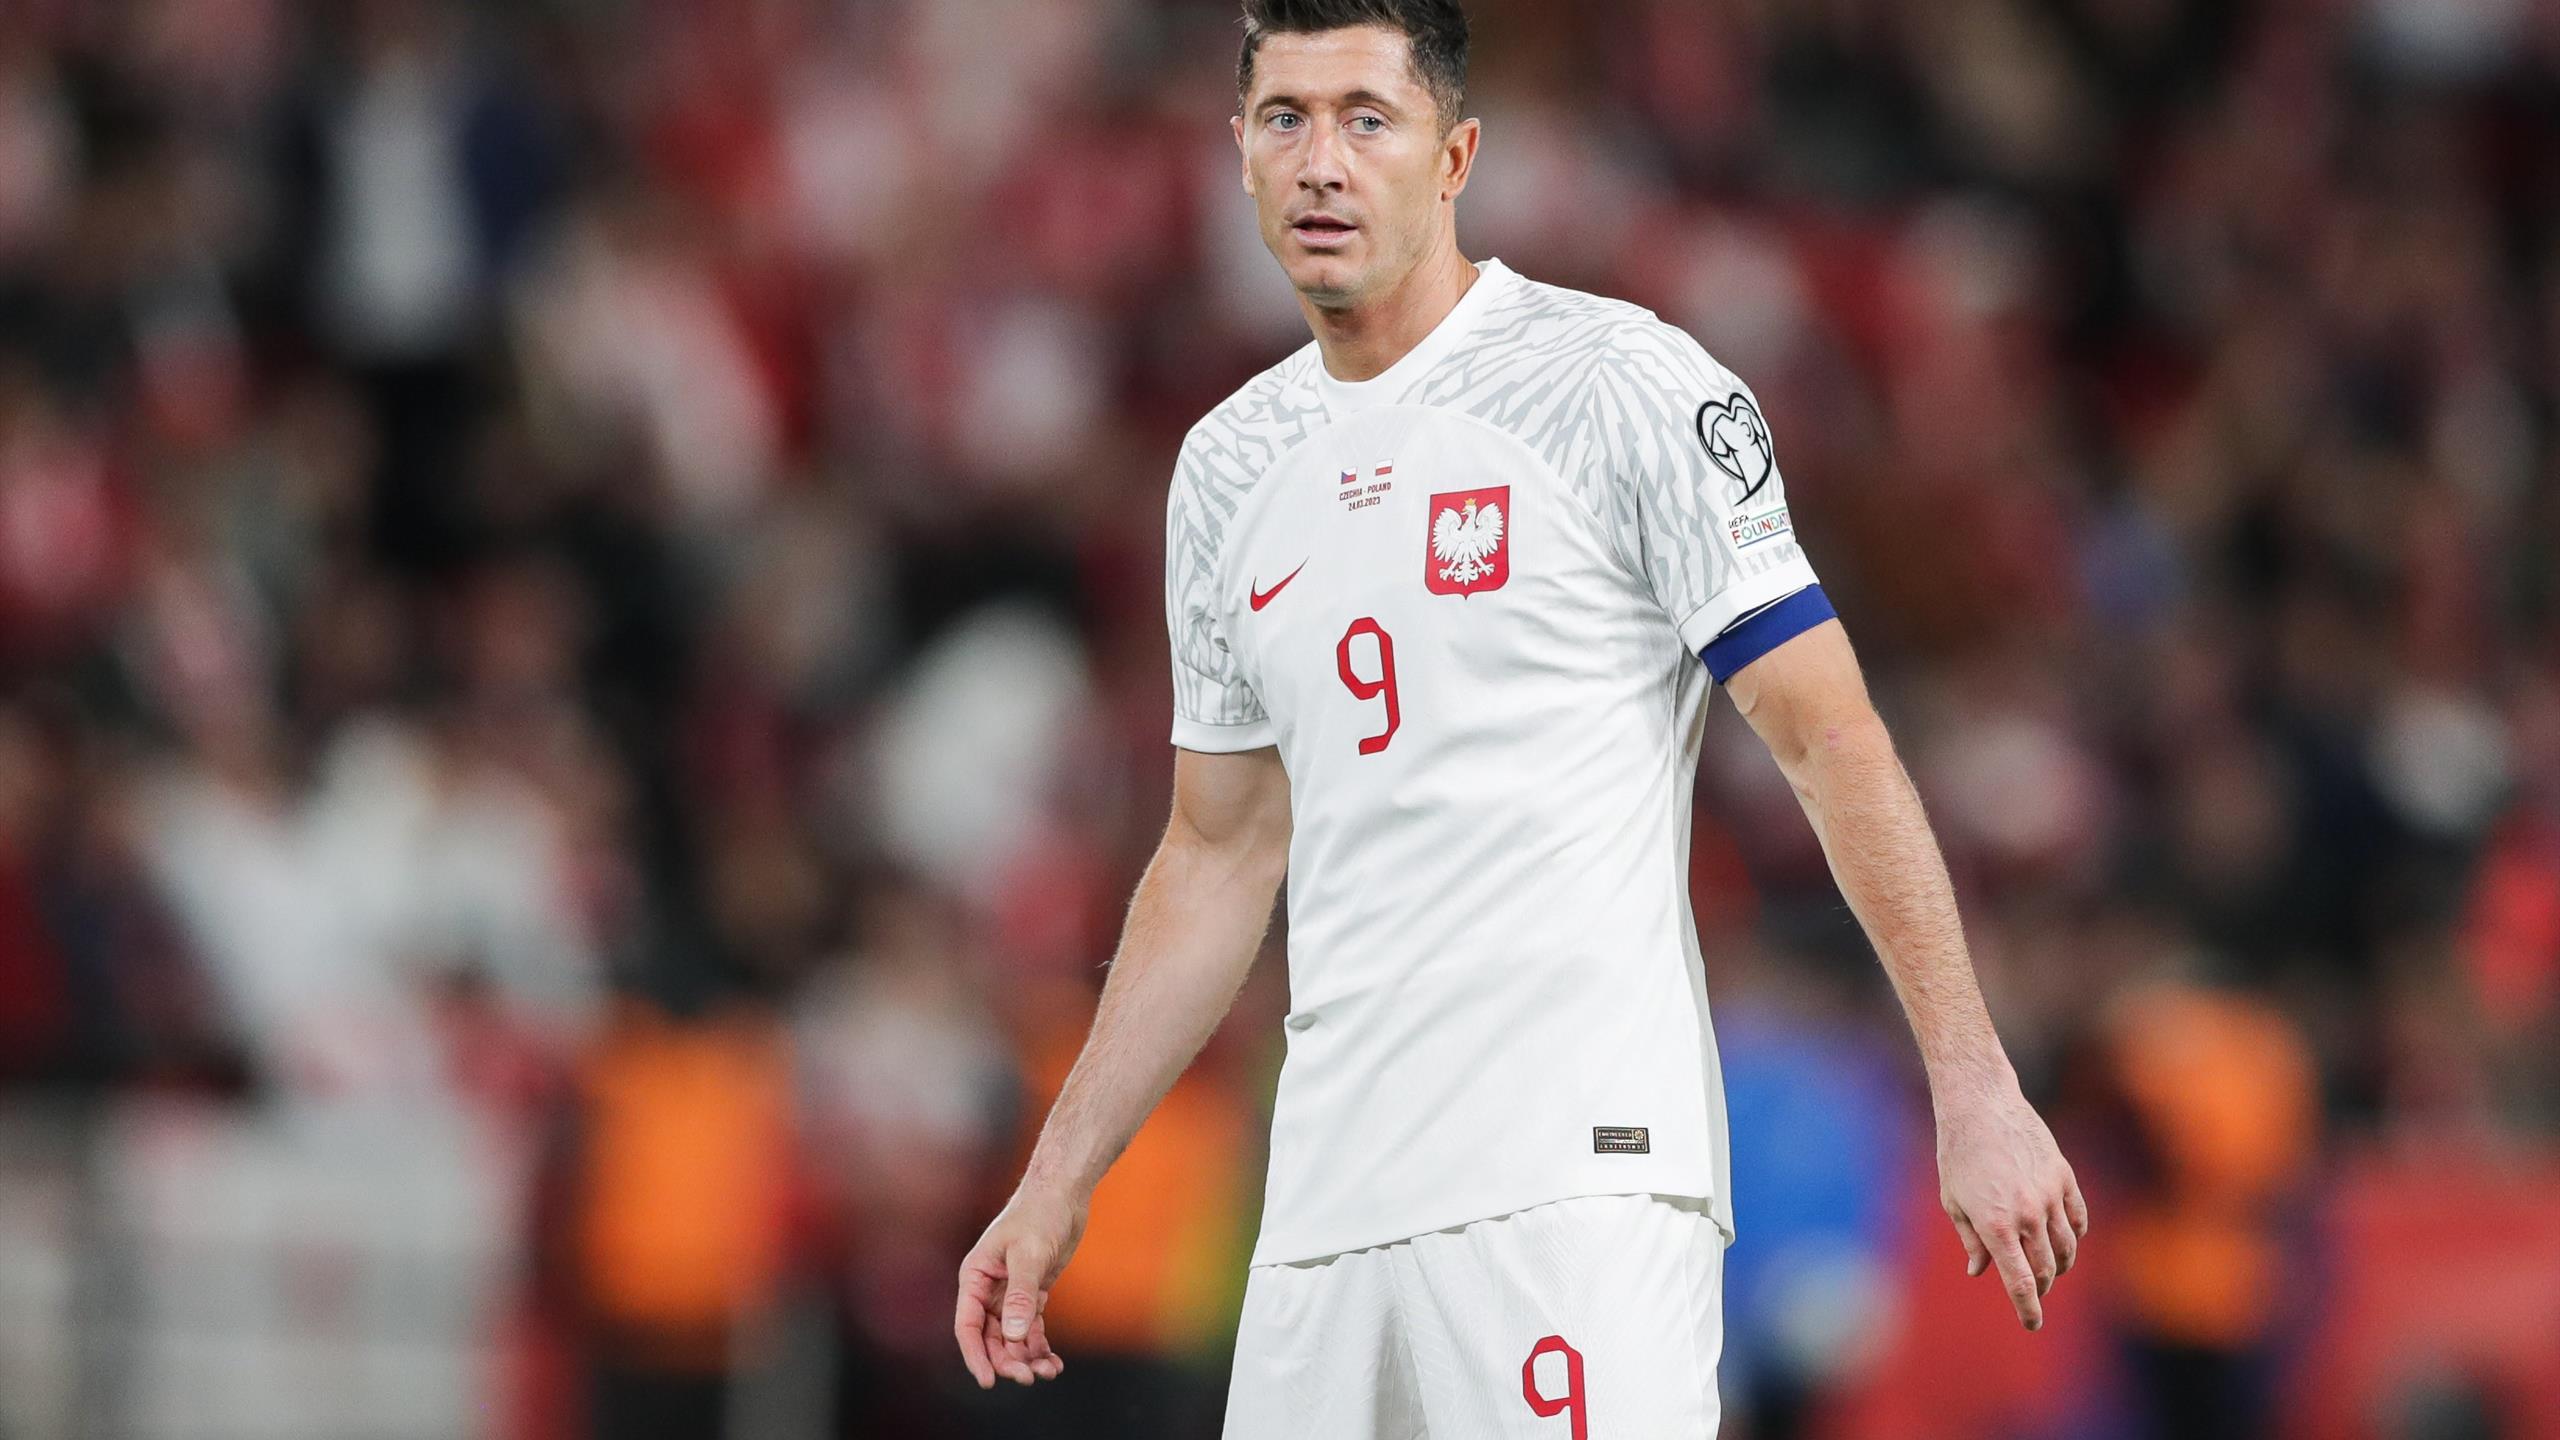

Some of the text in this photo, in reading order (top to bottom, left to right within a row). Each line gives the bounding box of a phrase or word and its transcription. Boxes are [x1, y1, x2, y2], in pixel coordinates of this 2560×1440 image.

[1367, 482, 1391, 494] POLAND
[1728, 515, 1749, 528] UEFA
[1336, 616, 1400, 756] 9
[1522, 1335, 1588, 1440] 9
